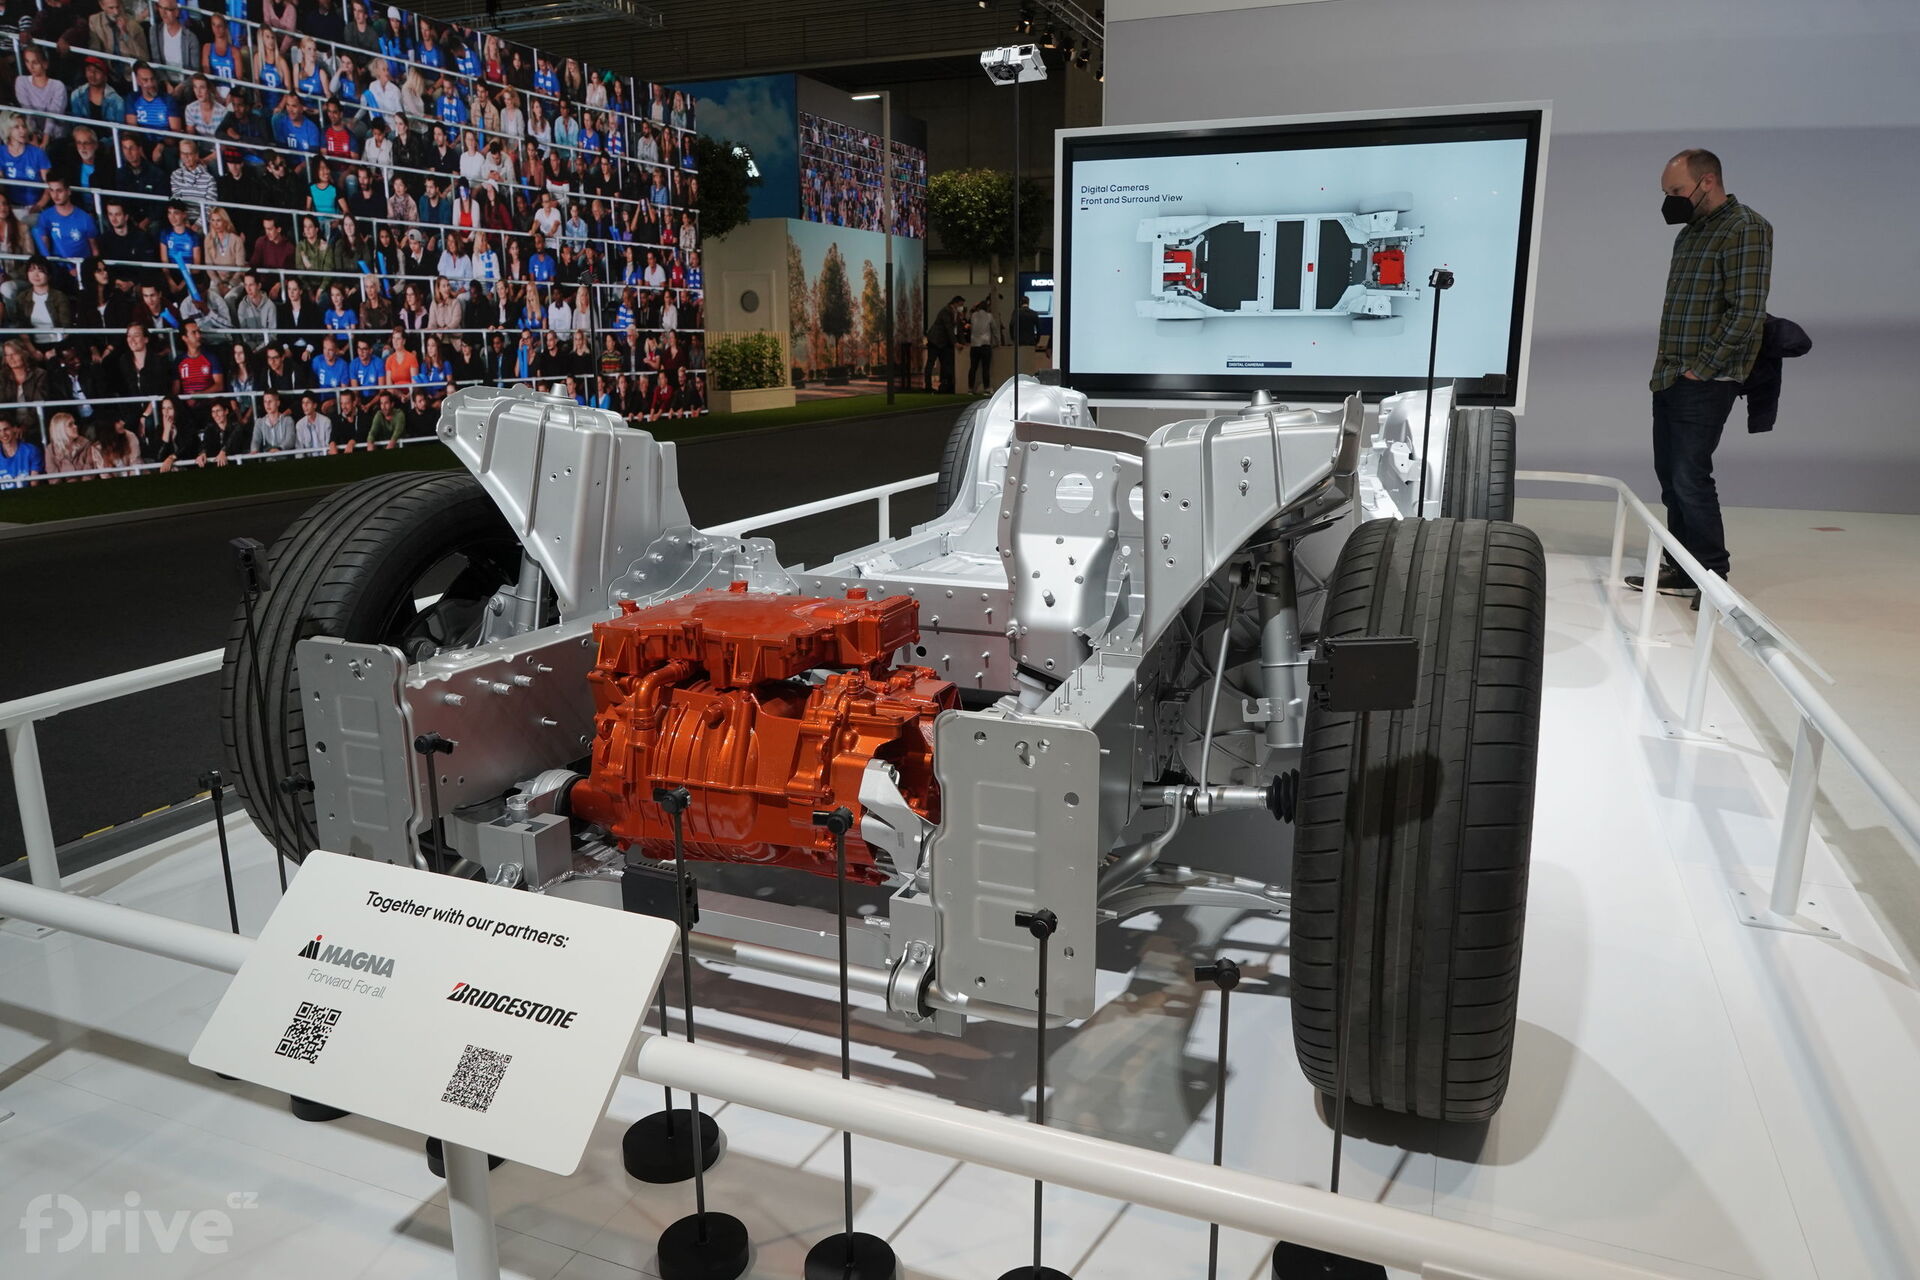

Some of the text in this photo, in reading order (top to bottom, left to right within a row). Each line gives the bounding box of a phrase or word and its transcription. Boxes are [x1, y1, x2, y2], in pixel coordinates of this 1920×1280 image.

[265, 72, 277, 88] 9
[1080, 194, 1183, 205] Front and Surround View
[1081, 184, 1150, 195] Digital Cameras
[366, 891, 570, 949] Together with our partners:
[319, 944, 396, 978] MAGNA
[308, 968, 354, 991] Forward.
[446, 982, 578, 1029] BRIDGESTONE
